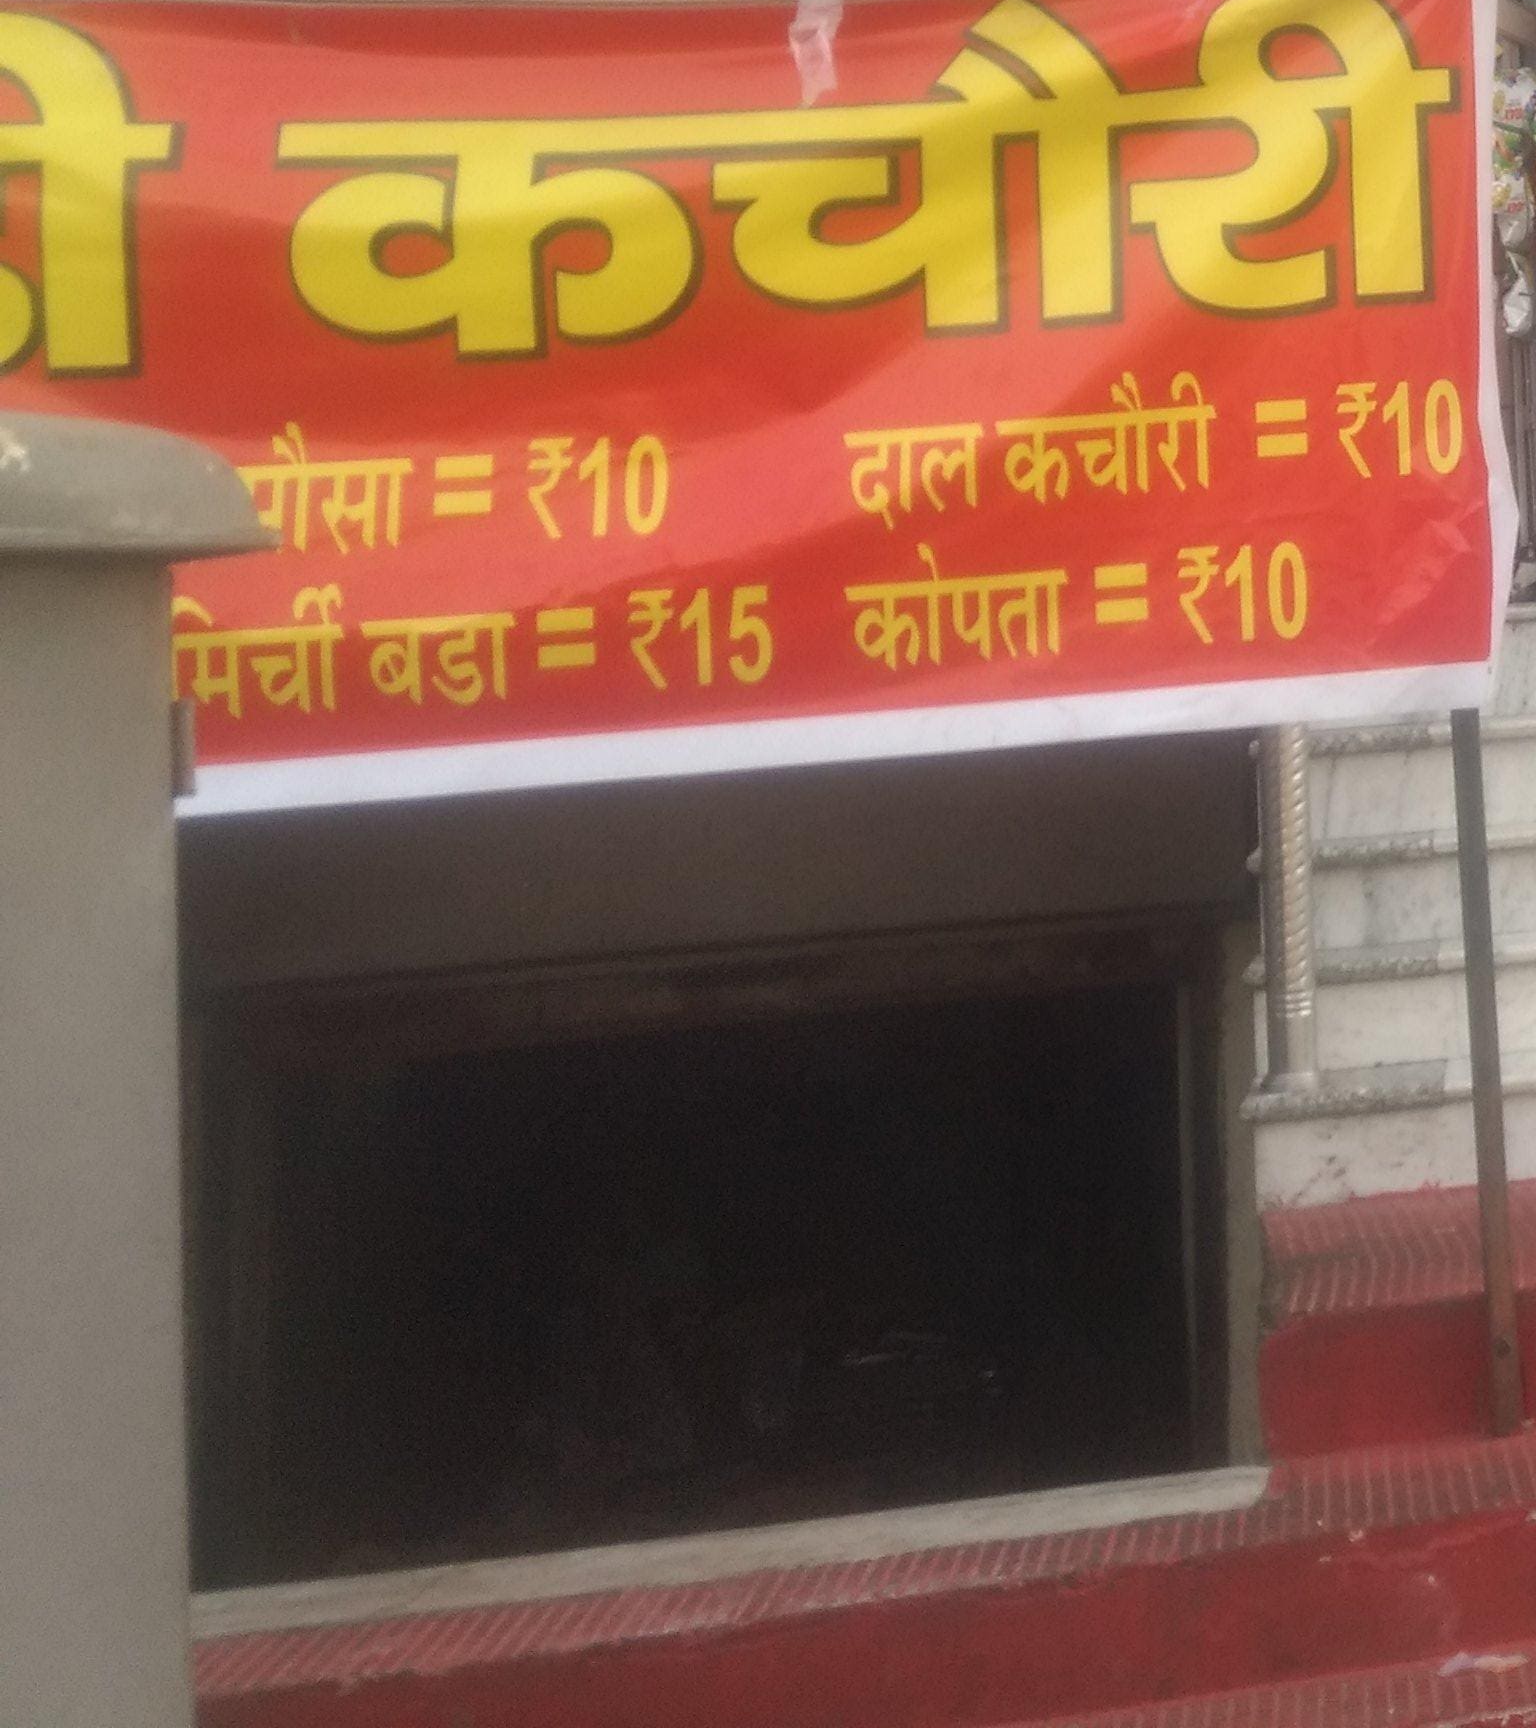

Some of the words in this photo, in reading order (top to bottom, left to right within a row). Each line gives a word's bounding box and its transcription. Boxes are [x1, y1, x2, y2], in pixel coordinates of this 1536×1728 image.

[433, 454, 494, 517] =
[526, 434, 669, 540] ₹10
[844, 421, 983, 530] दाल
[995, 370, 1217, 504] कचौरी
[1254, 398, 1309, 459] =
[1334, 377, 1464, 479] ₹10
[360, 612, 516, 707] बडा
[536, 606, 596, 670] =
[627, 584, 775, 691] ₹15
[844, 542, 1068, 672] कोपता
[1094, 562, 1150, 625] =
[1176, 540, 1309, 645] ₹10
